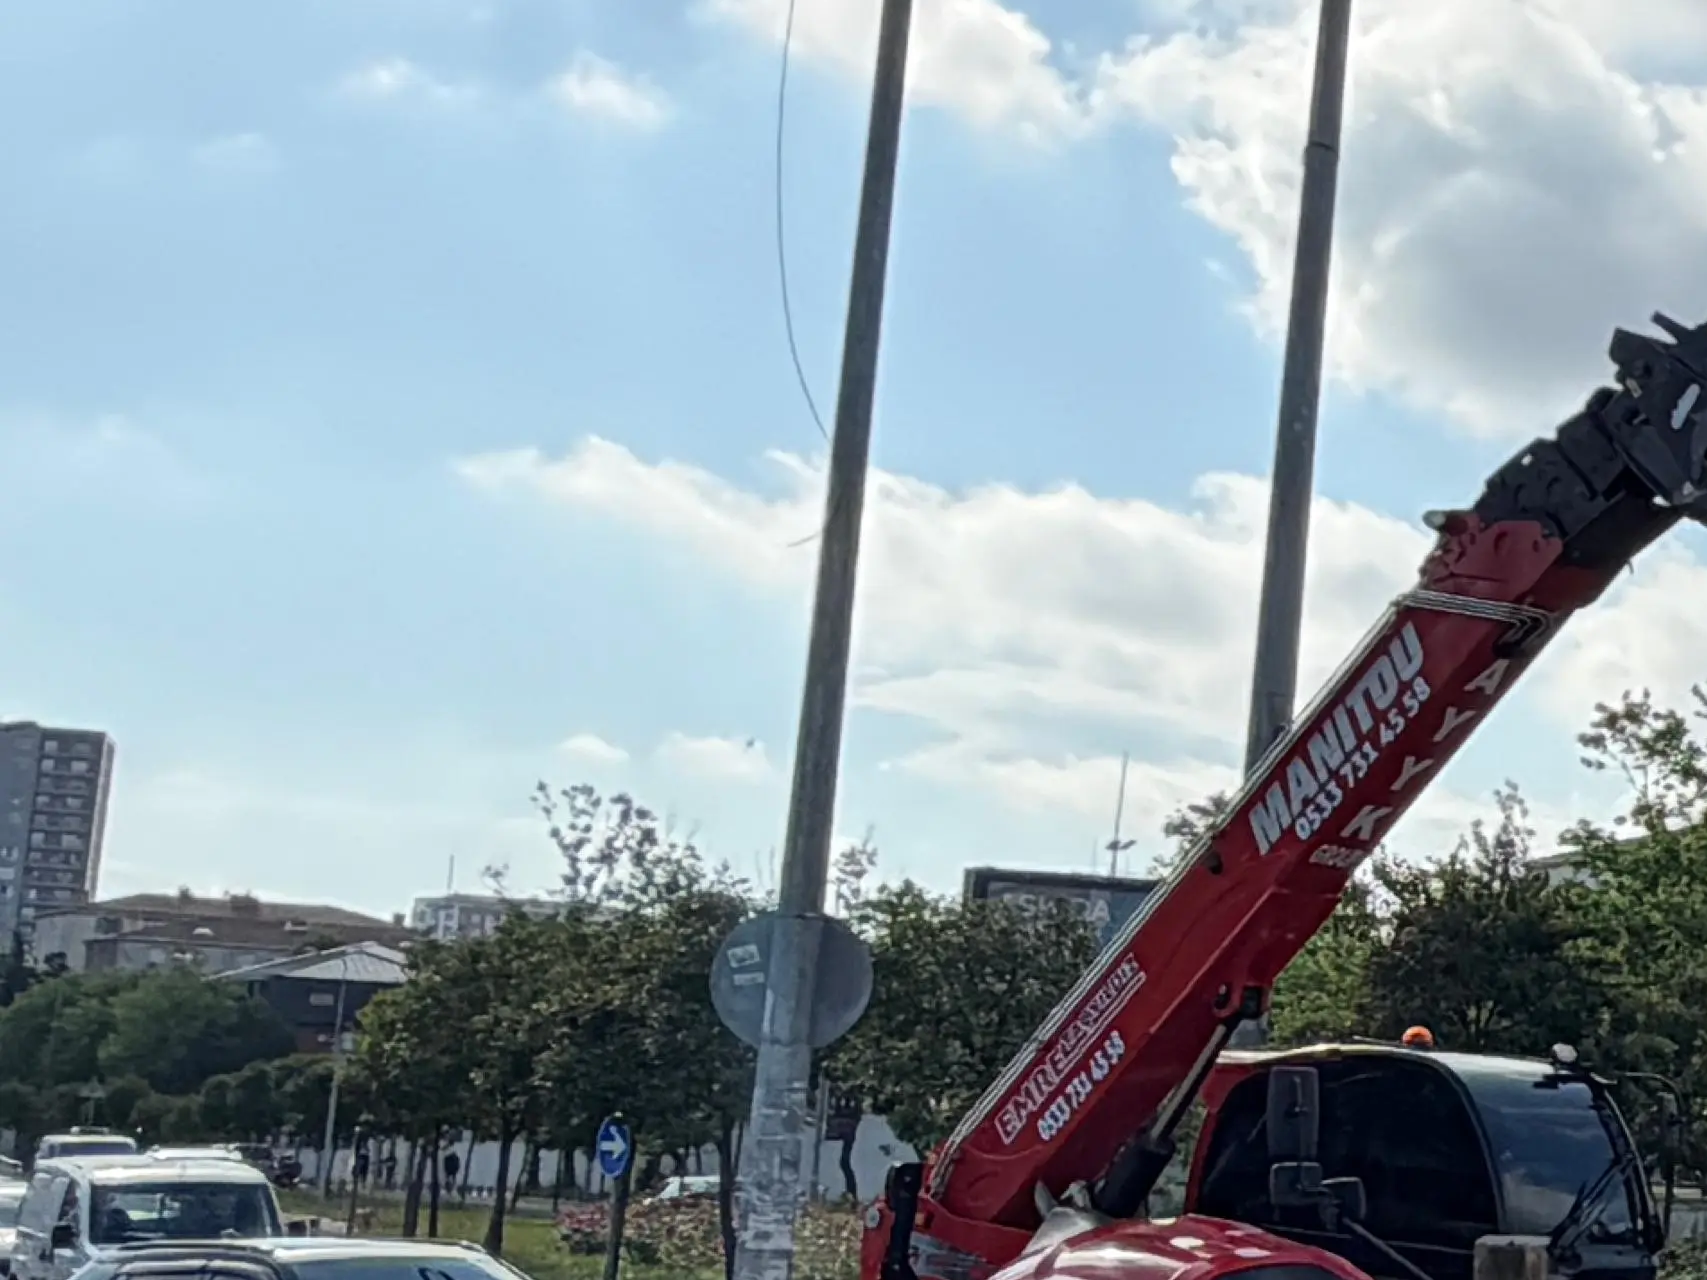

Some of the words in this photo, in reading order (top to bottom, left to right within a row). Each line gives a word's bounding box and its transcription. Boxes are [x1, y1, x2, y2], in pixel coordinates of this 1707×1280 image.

[1250, 621, 1424, 856] MANITOU
[1294, 780, 1343, 840] 0533
[1339, 741, 1378, 788] 731
[1379, 708, 1406, 747] 45
[1402, 677, 1431, 717] 58
[994, 1044, 1065, 1145] EMRE
